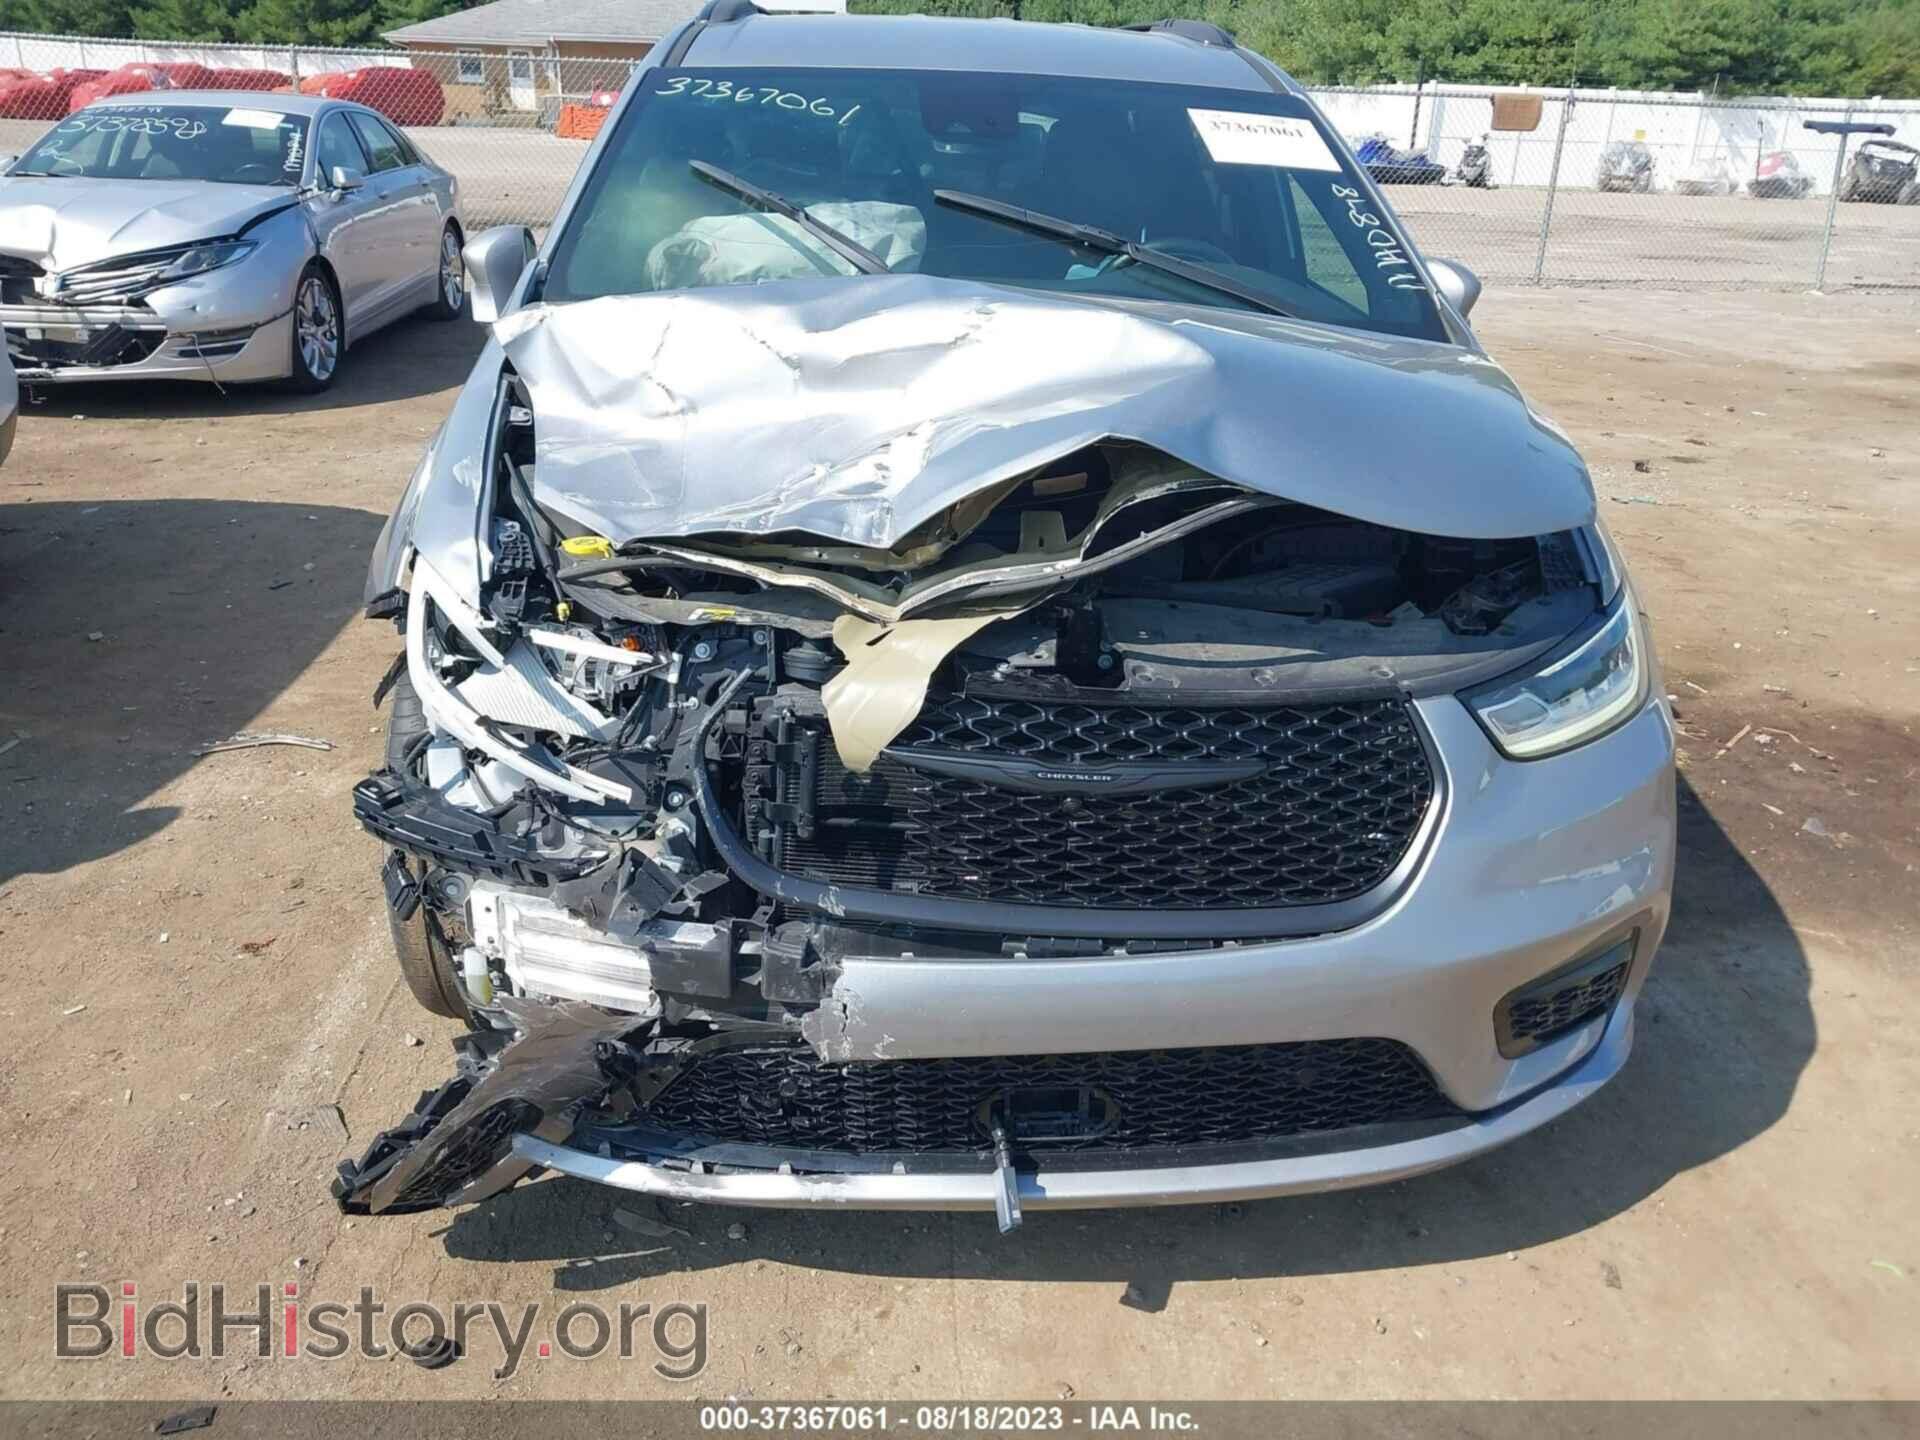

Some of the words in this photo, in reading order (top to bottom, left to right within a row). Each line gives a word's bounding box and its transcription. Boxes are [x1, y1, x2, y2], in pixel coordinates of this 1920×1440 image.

[655, 77, 861, 125] 37367061
[1210, 120, 1304, 138] 37367061
[1037, 772, 1112, 781] CHRYSLER
